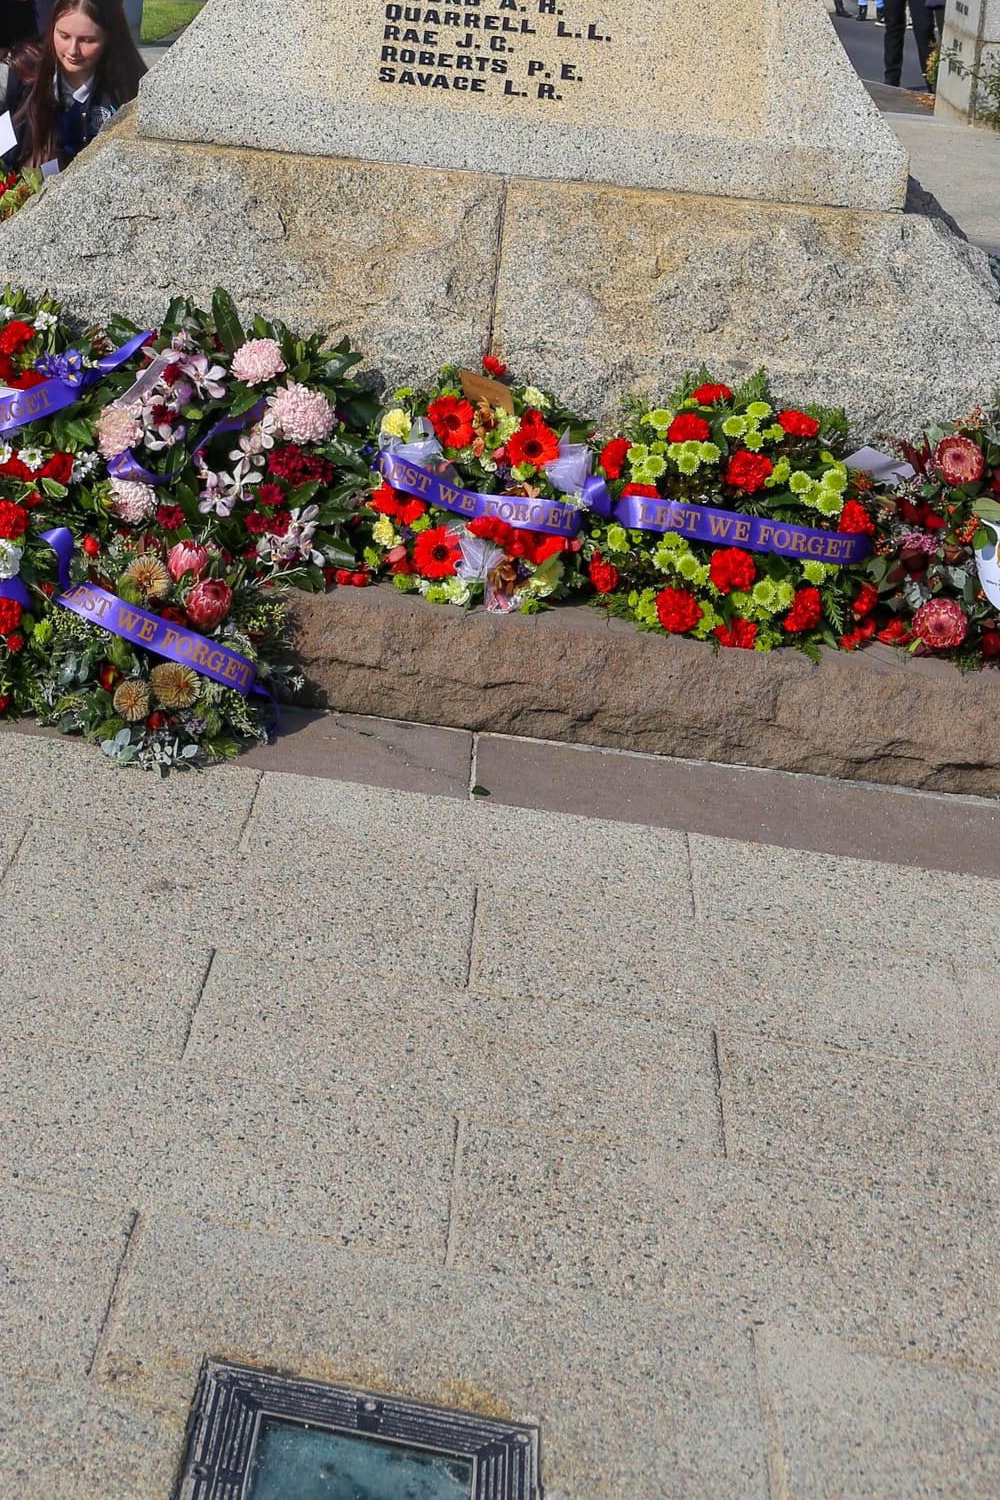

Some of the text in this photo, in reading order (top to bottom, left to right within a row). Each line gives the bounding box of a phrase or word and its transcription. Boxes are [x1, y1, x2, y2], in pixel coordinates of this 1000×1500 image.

[385, 4, 537, 34] QUARRELL
[383, 25, 439, 45] RAE
[381, 46, 508, 73] ROBERTS
[378, 67, 486, 92] SAVAGE
[378, 457, 577, 531] LEST WE FORGET
[638, 503, 856, 559] LEST WE FORGET
[60, 584, 255, 687] LEST WE FORGET
